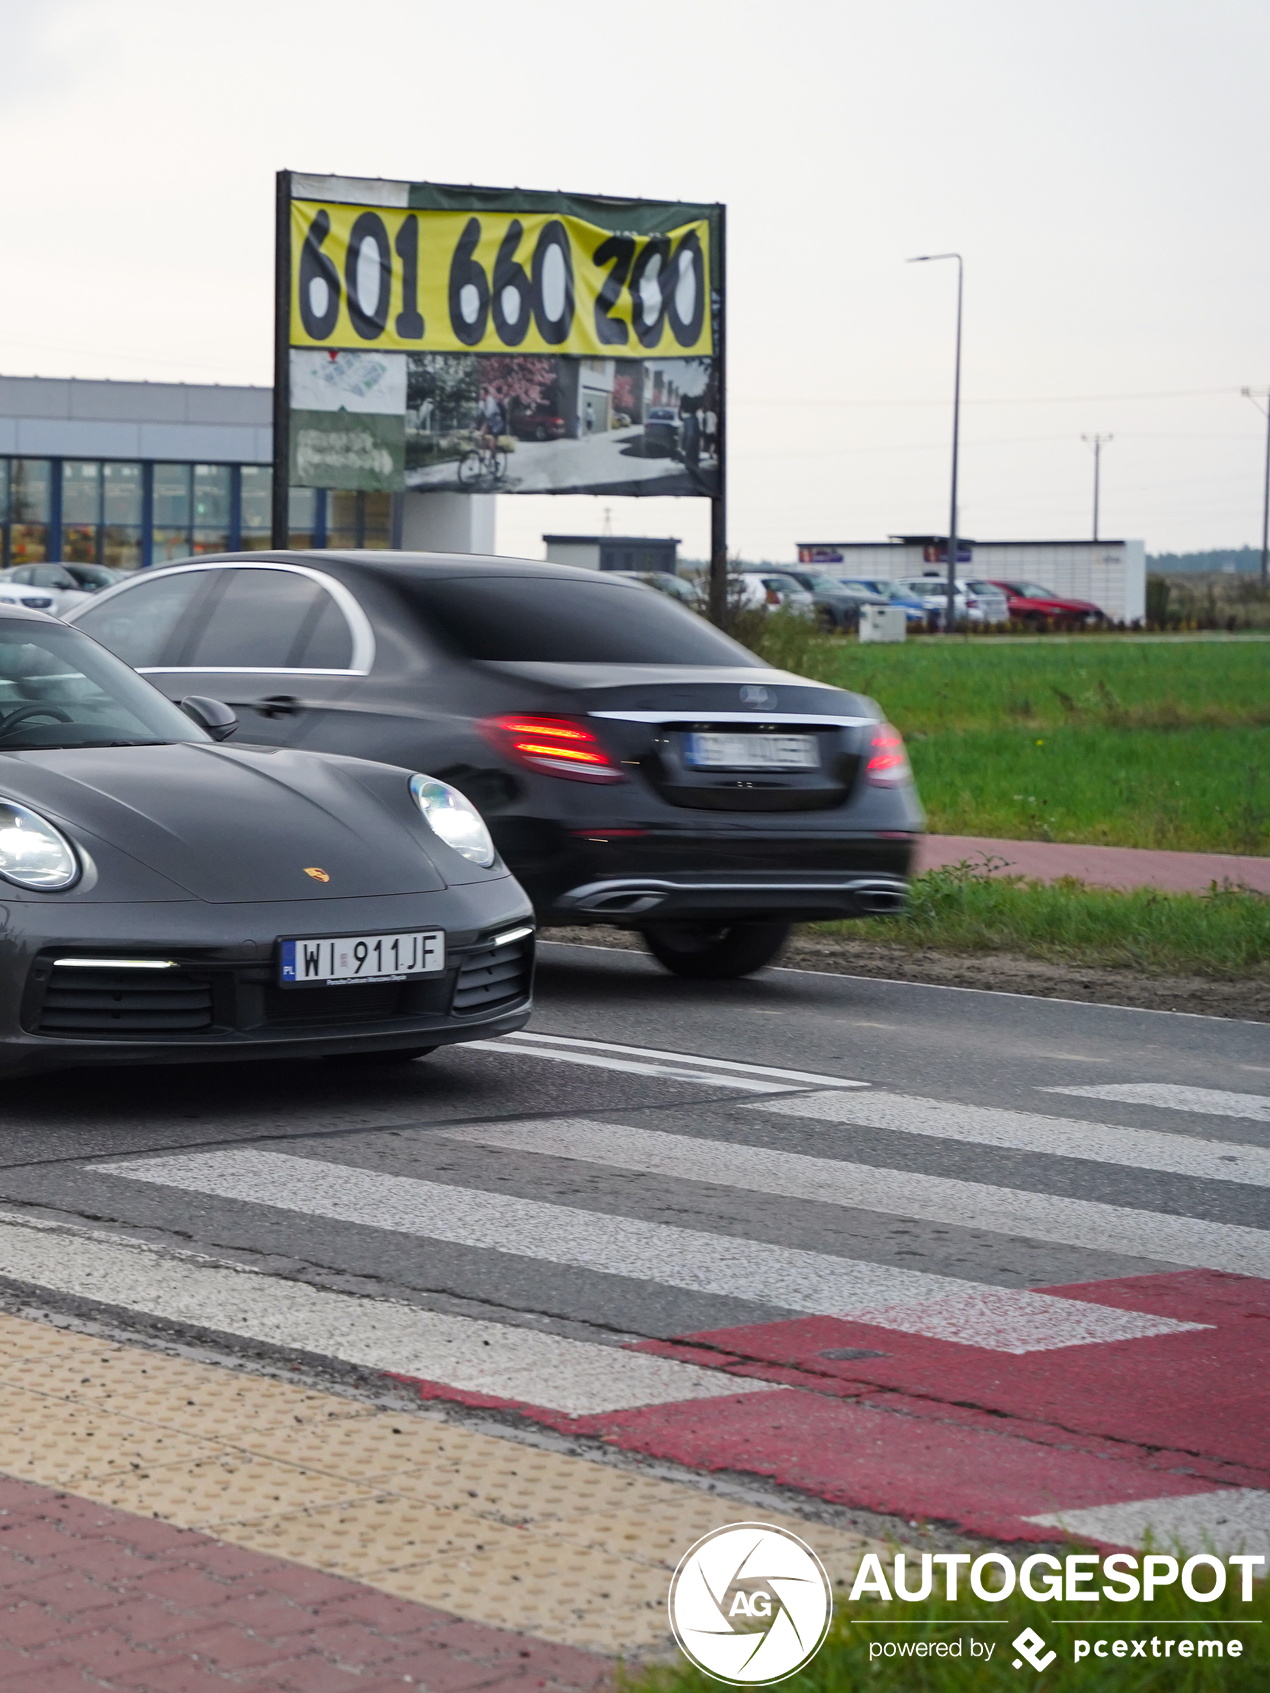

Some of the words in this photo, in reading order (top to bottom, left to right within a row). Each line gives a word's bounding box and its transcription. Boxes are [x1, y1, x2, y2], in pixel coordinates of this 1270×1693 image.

[298, 208, 426, 341] 601
[448, 216, 577, 347] 660
[591, 228, 707, 349] 200
[282, 965, 295, 976] PL
[303, 942, 335, 978] WI
[353, 934, 438, 975] 911JF
